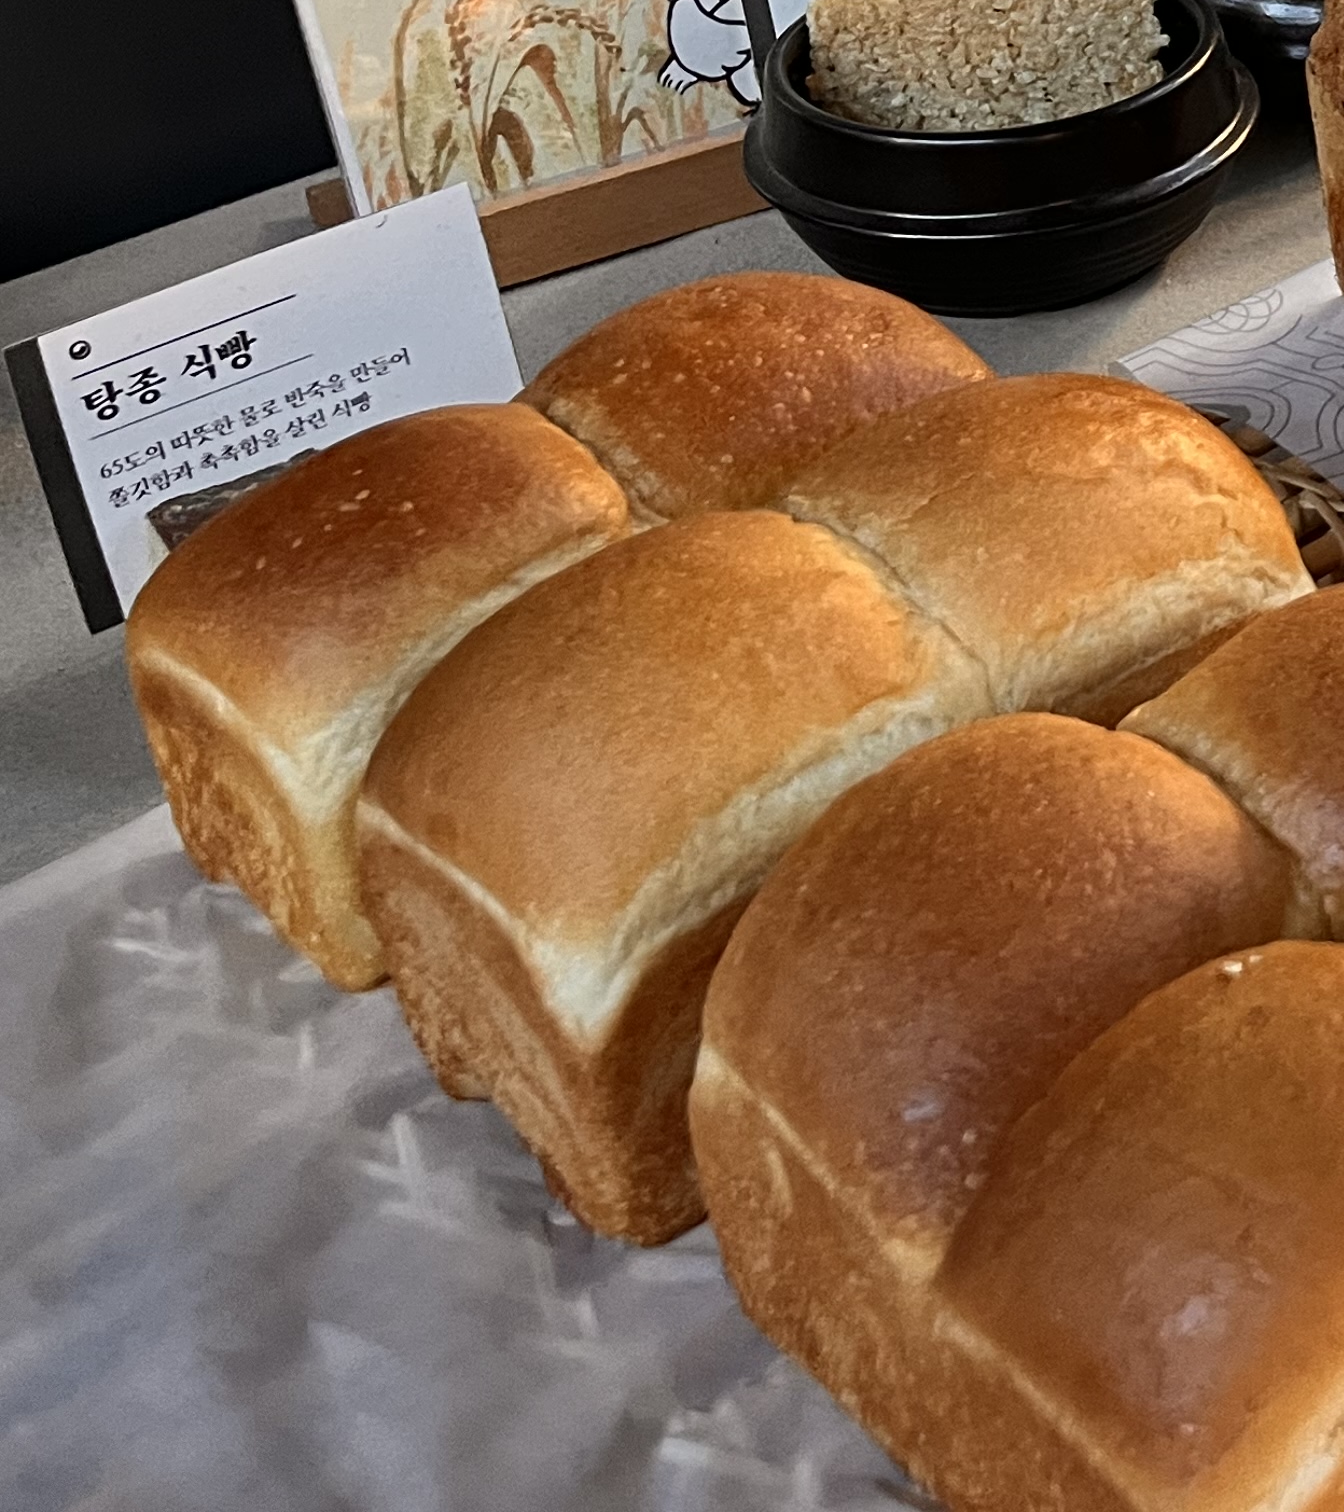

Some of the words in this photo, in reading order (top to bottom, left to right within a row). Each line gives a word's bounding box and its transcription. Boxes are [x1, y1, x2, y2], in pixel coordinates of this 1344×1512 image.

[81, 366, 167, 420] 탕종
[180, 330, 257, 380] 식빵
[100, 441, 166, 478] 65도의
[171, 415, 235, 449] 따뜻한
[239, 399, 283, 428] 물로
[284, 374, 347, 409] 반죽을
[350, 347, 411, 383] 만들어
[108, 461, 194, 508] 쫄깃함과
[200, 429, 280, 470] 촉촉함을
[285, 409, 328, 438] 살린
[332, 391, 372, 417] 식빵
